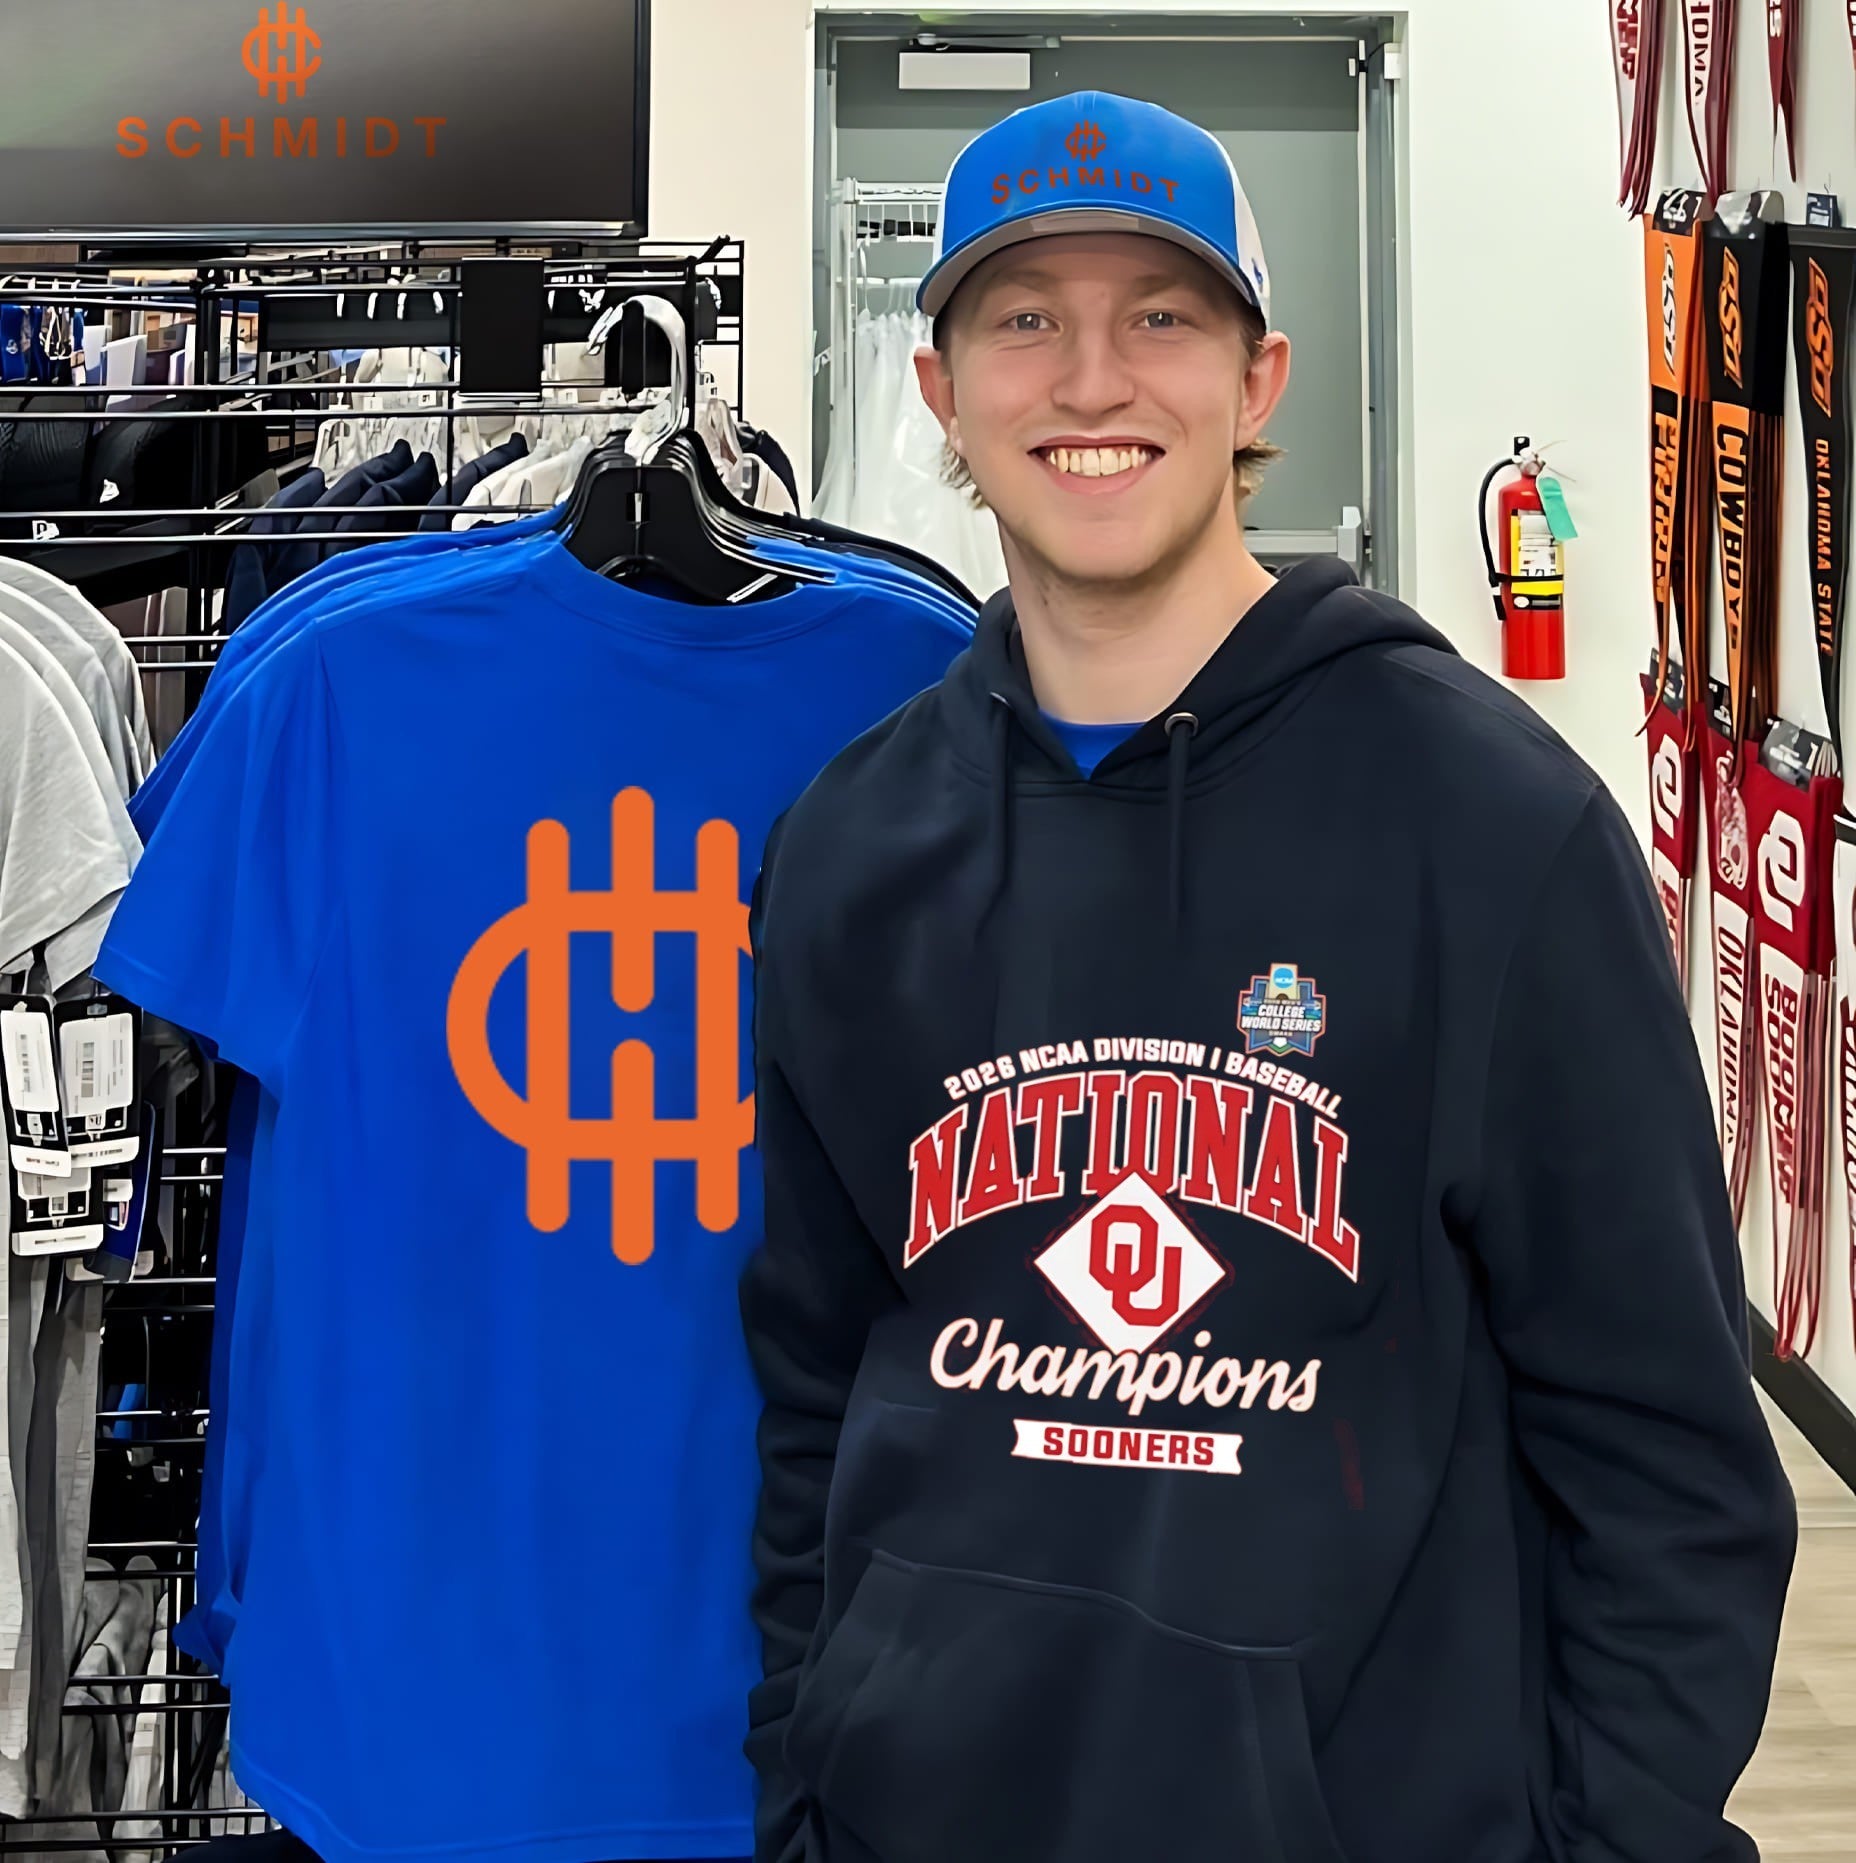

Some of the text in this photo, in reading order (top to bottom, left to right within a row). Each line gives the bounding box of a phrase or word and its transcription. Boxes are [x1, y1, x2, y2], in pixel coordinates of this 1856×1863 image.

[116, 117, 447, 159] SCHMIDT
[991, 167, 1179, 205] SCHMIDT
[1241, 1016, 1321, 1032] WORLD SERIES
[1258, 1004, 1305, 1019] COLLEGE
[1718, 926, 1745, 1144] OKLAHOMA
[943, 1037, 1342, 1120] 2026 NCAA DIVISION I BASEBALL
[904, 1069, 1361, 1284] NATIONAL
[1088, 1204, 1183, 1327] OU
[929, 1316, 1322, 1416] Champions
[1042, 1426, 1215, 1467] SOONERS
